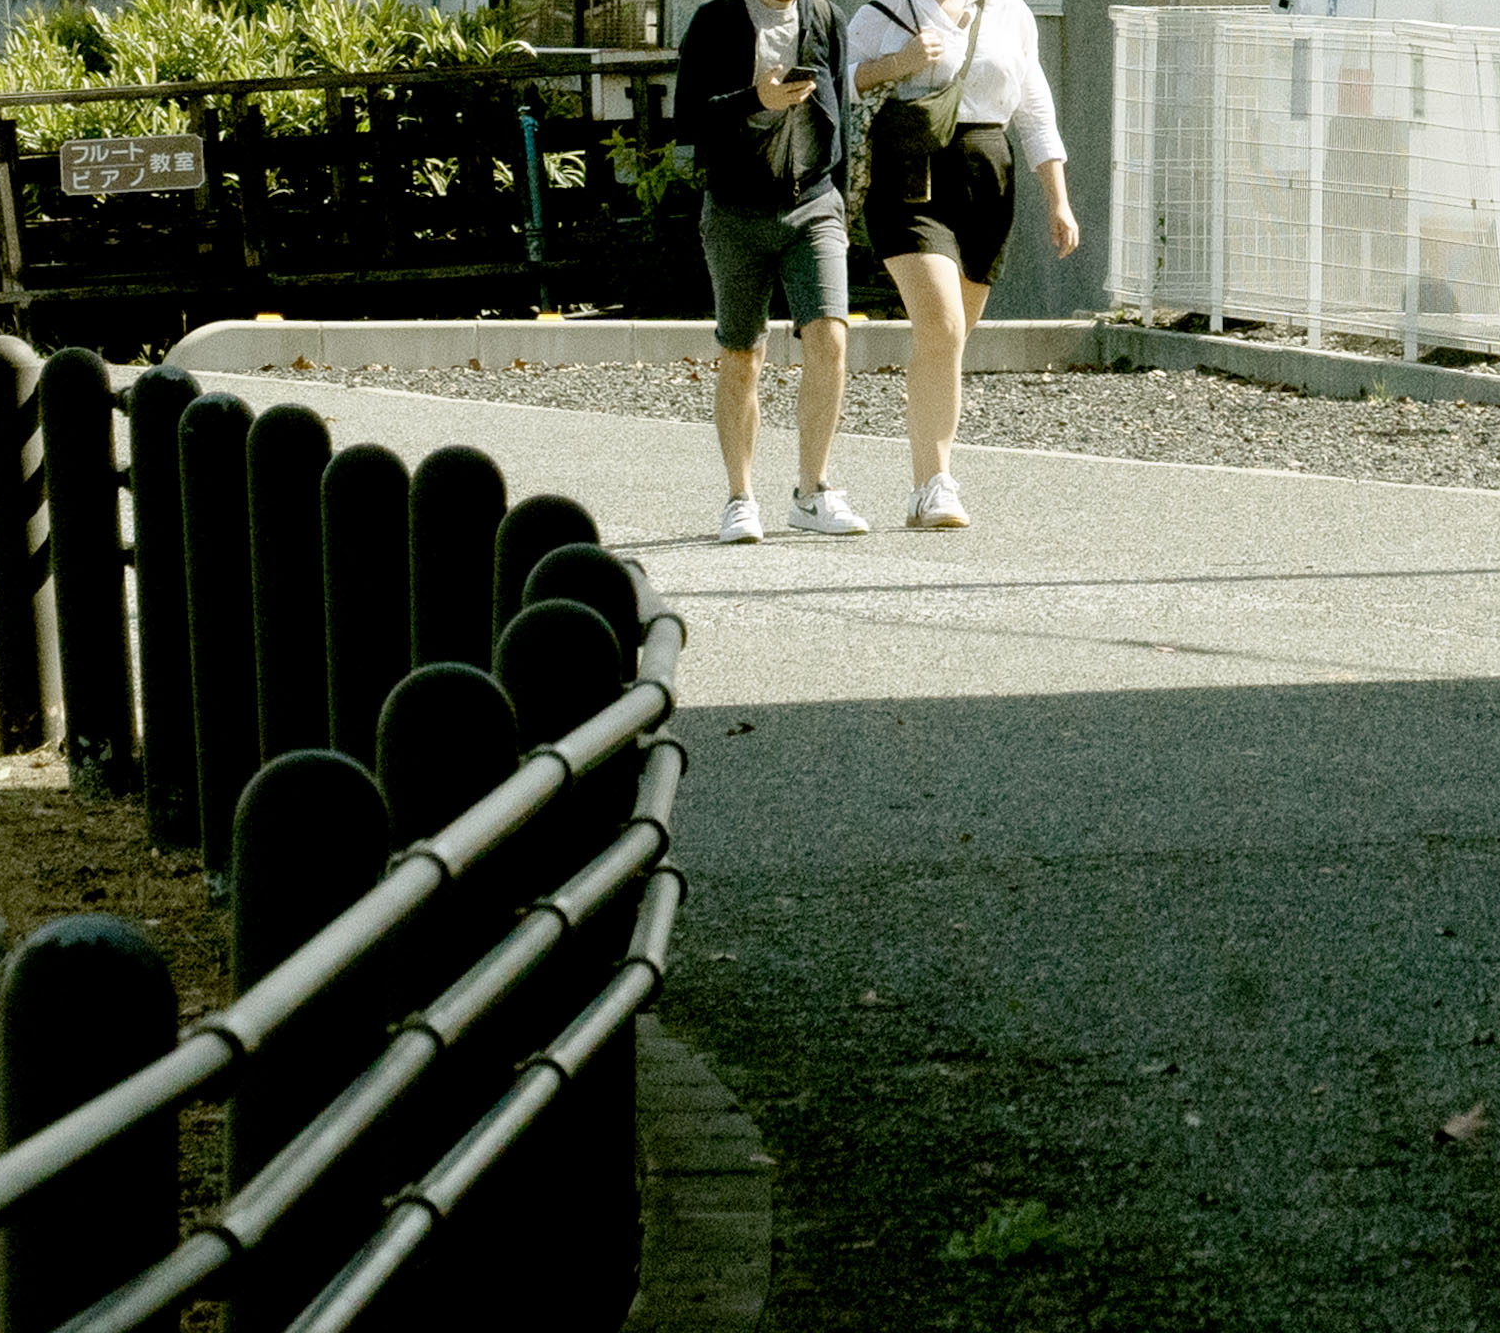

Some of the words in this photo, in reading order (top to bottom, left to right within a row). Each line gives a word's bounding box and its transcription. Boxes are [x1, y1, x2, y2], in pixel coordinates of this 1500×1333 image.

[71, 141, 145, 164] フルート
[150, 151, 195, 174] 教室
[72, 167, 145, 190] ピアノ
